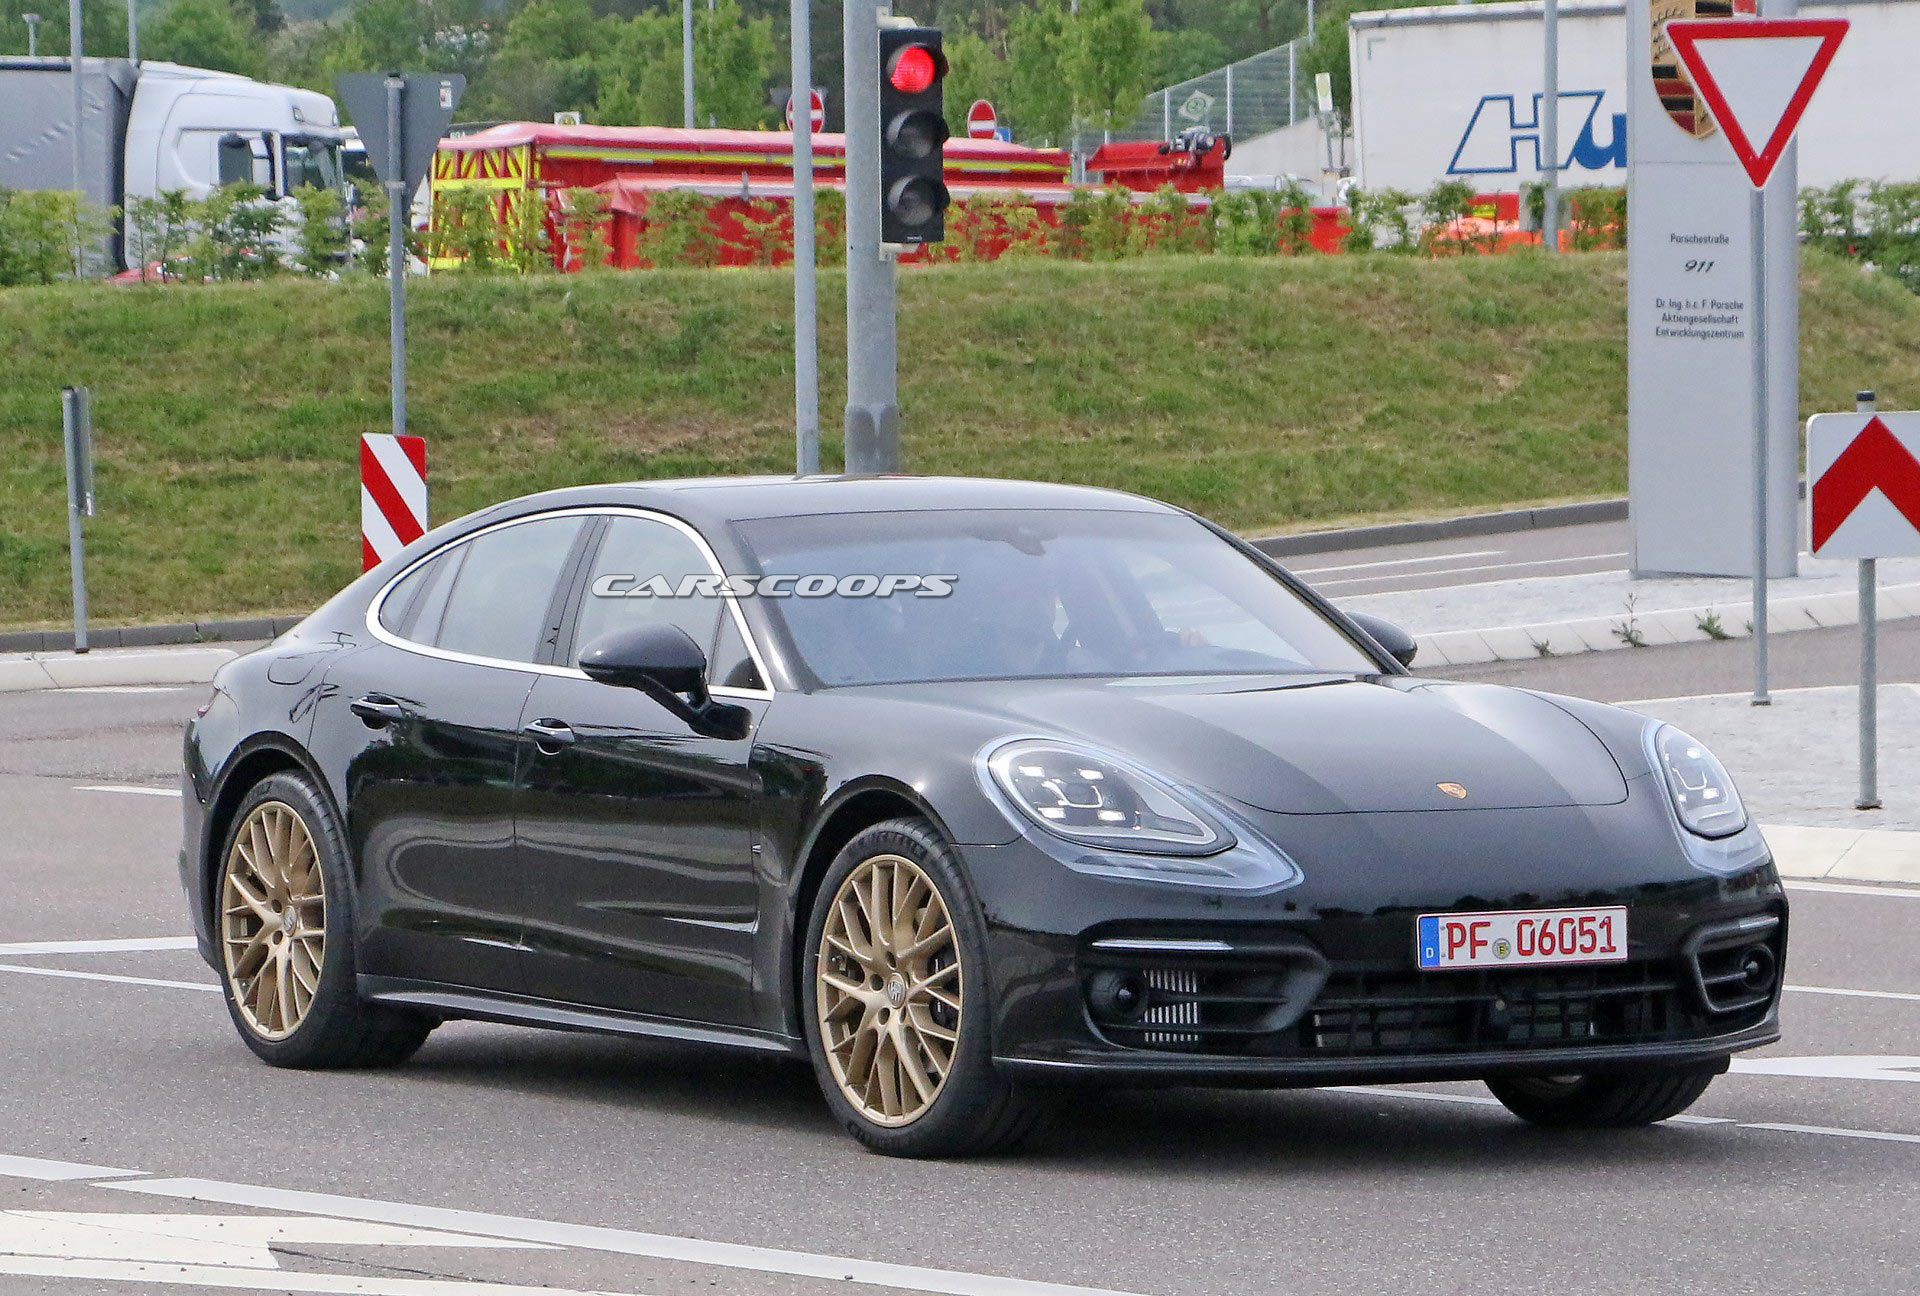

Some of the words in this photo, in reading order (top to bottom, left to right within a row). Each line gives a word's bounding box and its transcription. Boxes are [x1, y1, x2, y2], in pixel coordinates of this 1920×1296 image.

[1670, 233, 1729, 244] Porschestraße
[1685, 259, 1714, 272] 911
[1711, 300, 1744, 310] Porsche
[1662, 313, 1738, 325] Aktiengesellschaft
[1656, 326, 1744, 340] Entwicklungszentrum
[1426, 947, 1434, 959] D
[1446, 921, 1491, 960] PF
[1517, 916, 1617, 956] 06051
